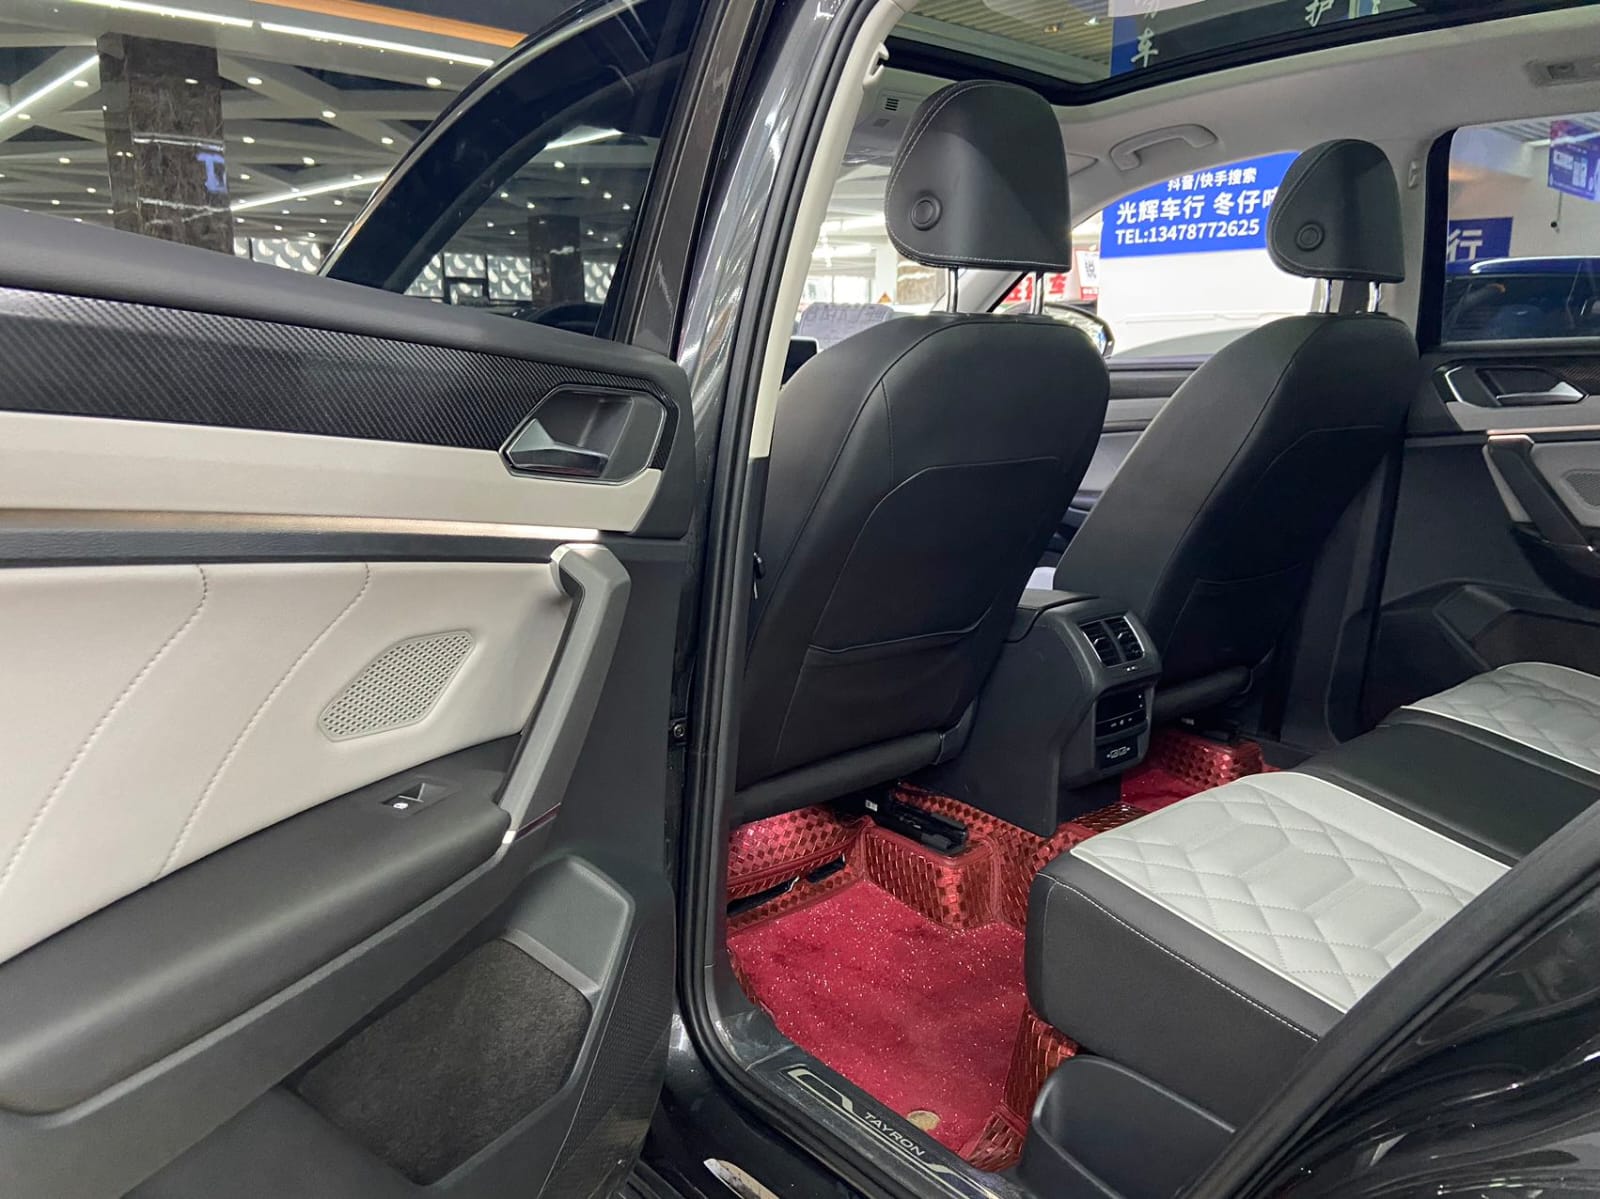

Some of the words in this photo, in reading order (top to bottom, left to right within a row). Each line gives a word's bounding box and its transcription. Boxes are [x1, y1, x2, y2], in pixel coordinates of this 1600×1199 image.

[1167, 167, 1257, 192] 抖音/快手搜索
[1116, 195, 1205, 225] 光辉车行
[1115, 219, 1260, 245] TEL:13478772625
[864, 1111, 926, 1156] TAYRON
